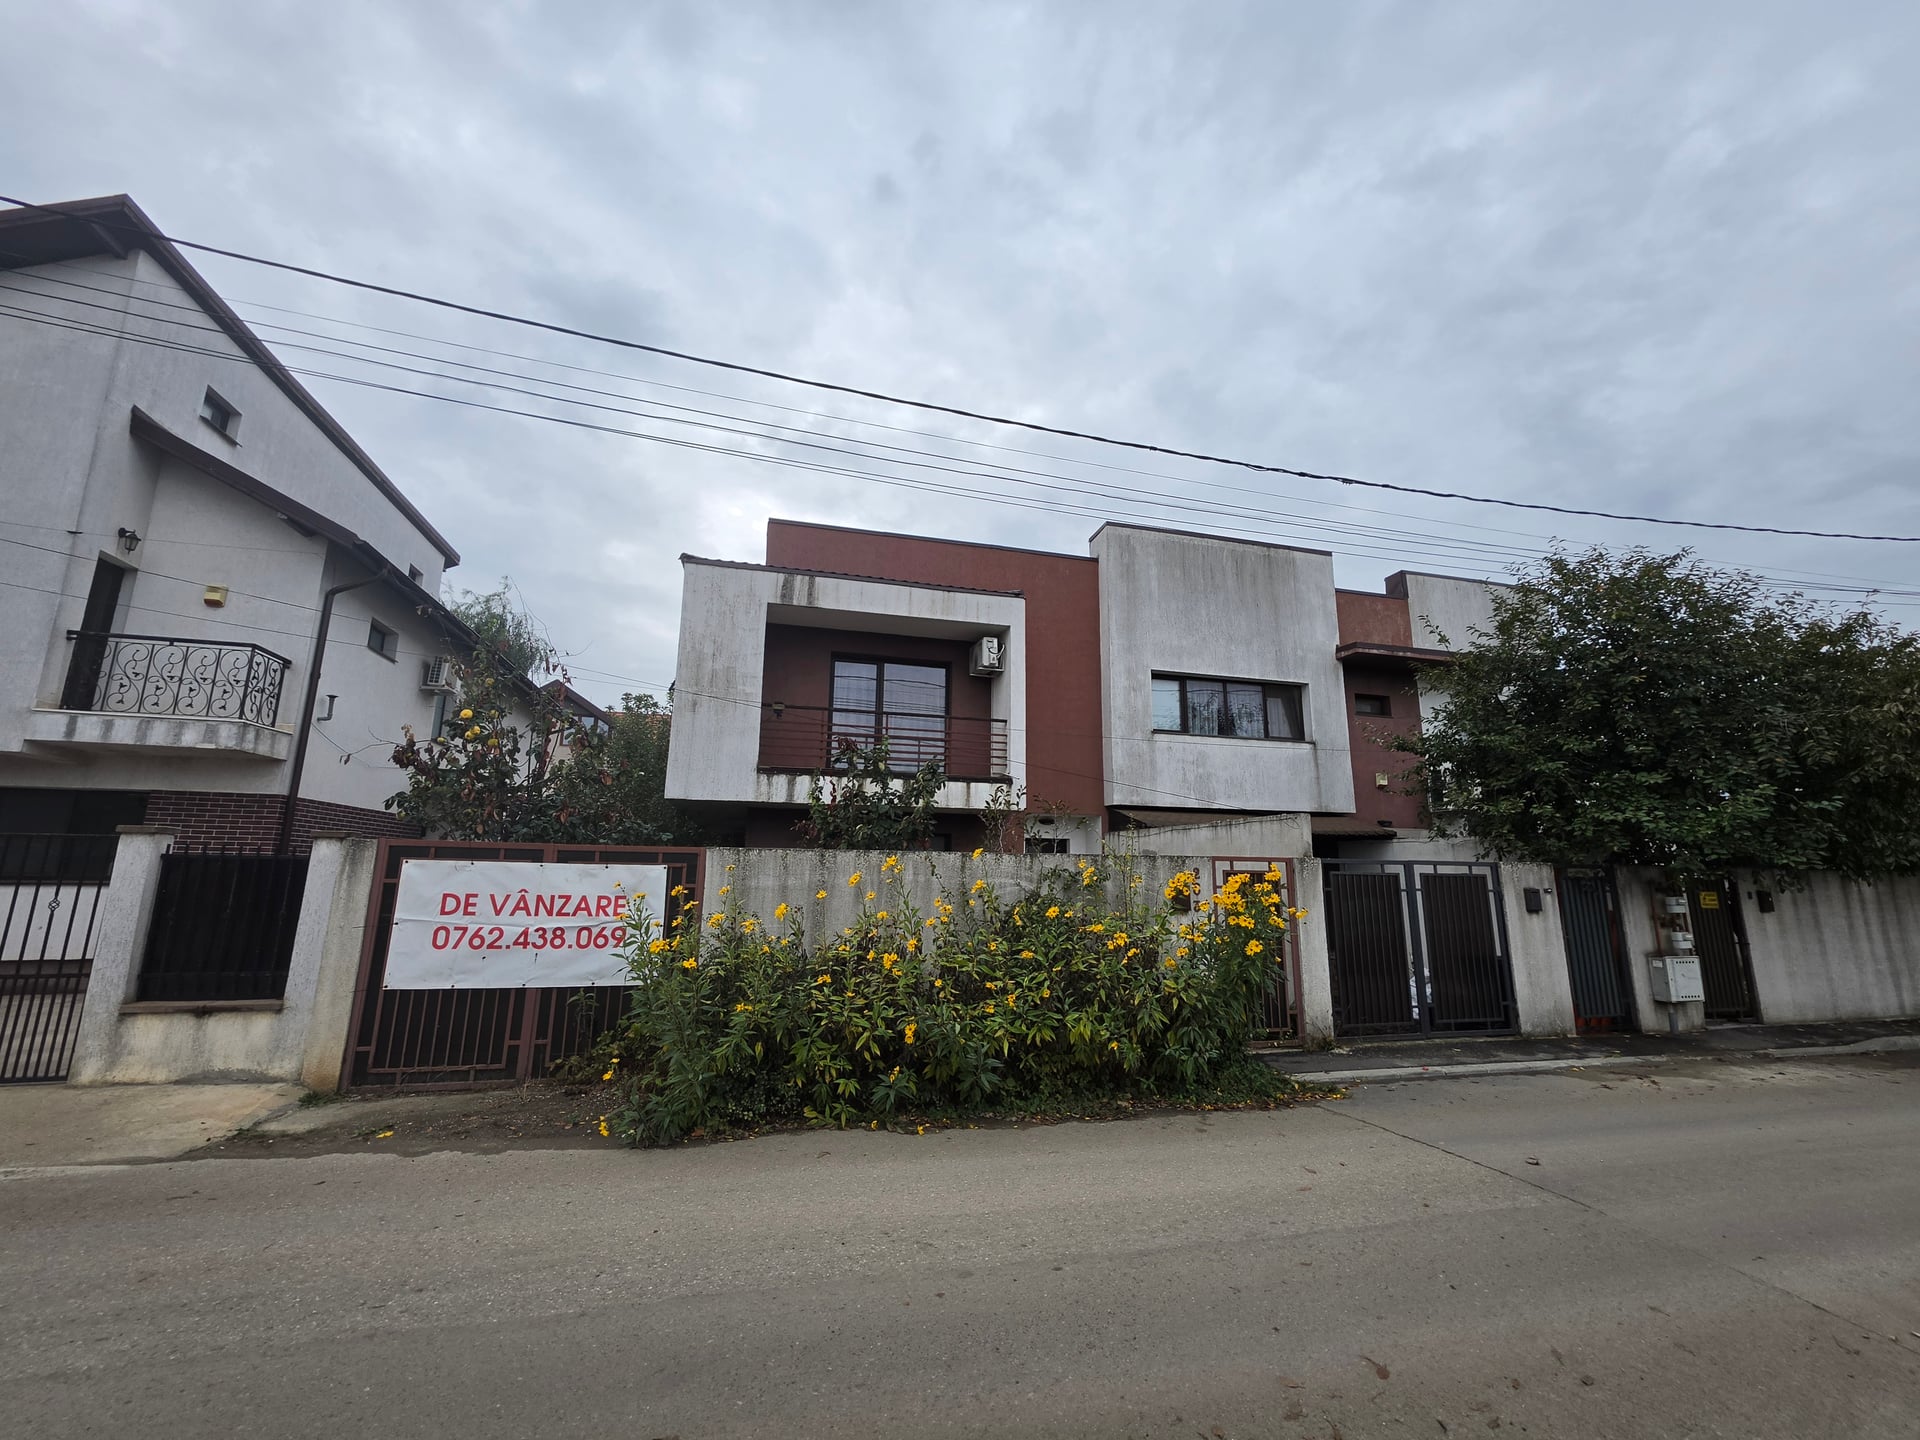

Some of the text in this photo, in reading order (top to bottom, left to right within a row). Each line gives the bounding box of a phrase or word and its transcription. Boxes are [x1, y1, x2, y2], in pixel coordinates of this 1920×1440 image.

[439, 888, 628, 918] DE VÂNZARE
[431, 926, 627, 950] 0762.438.069
